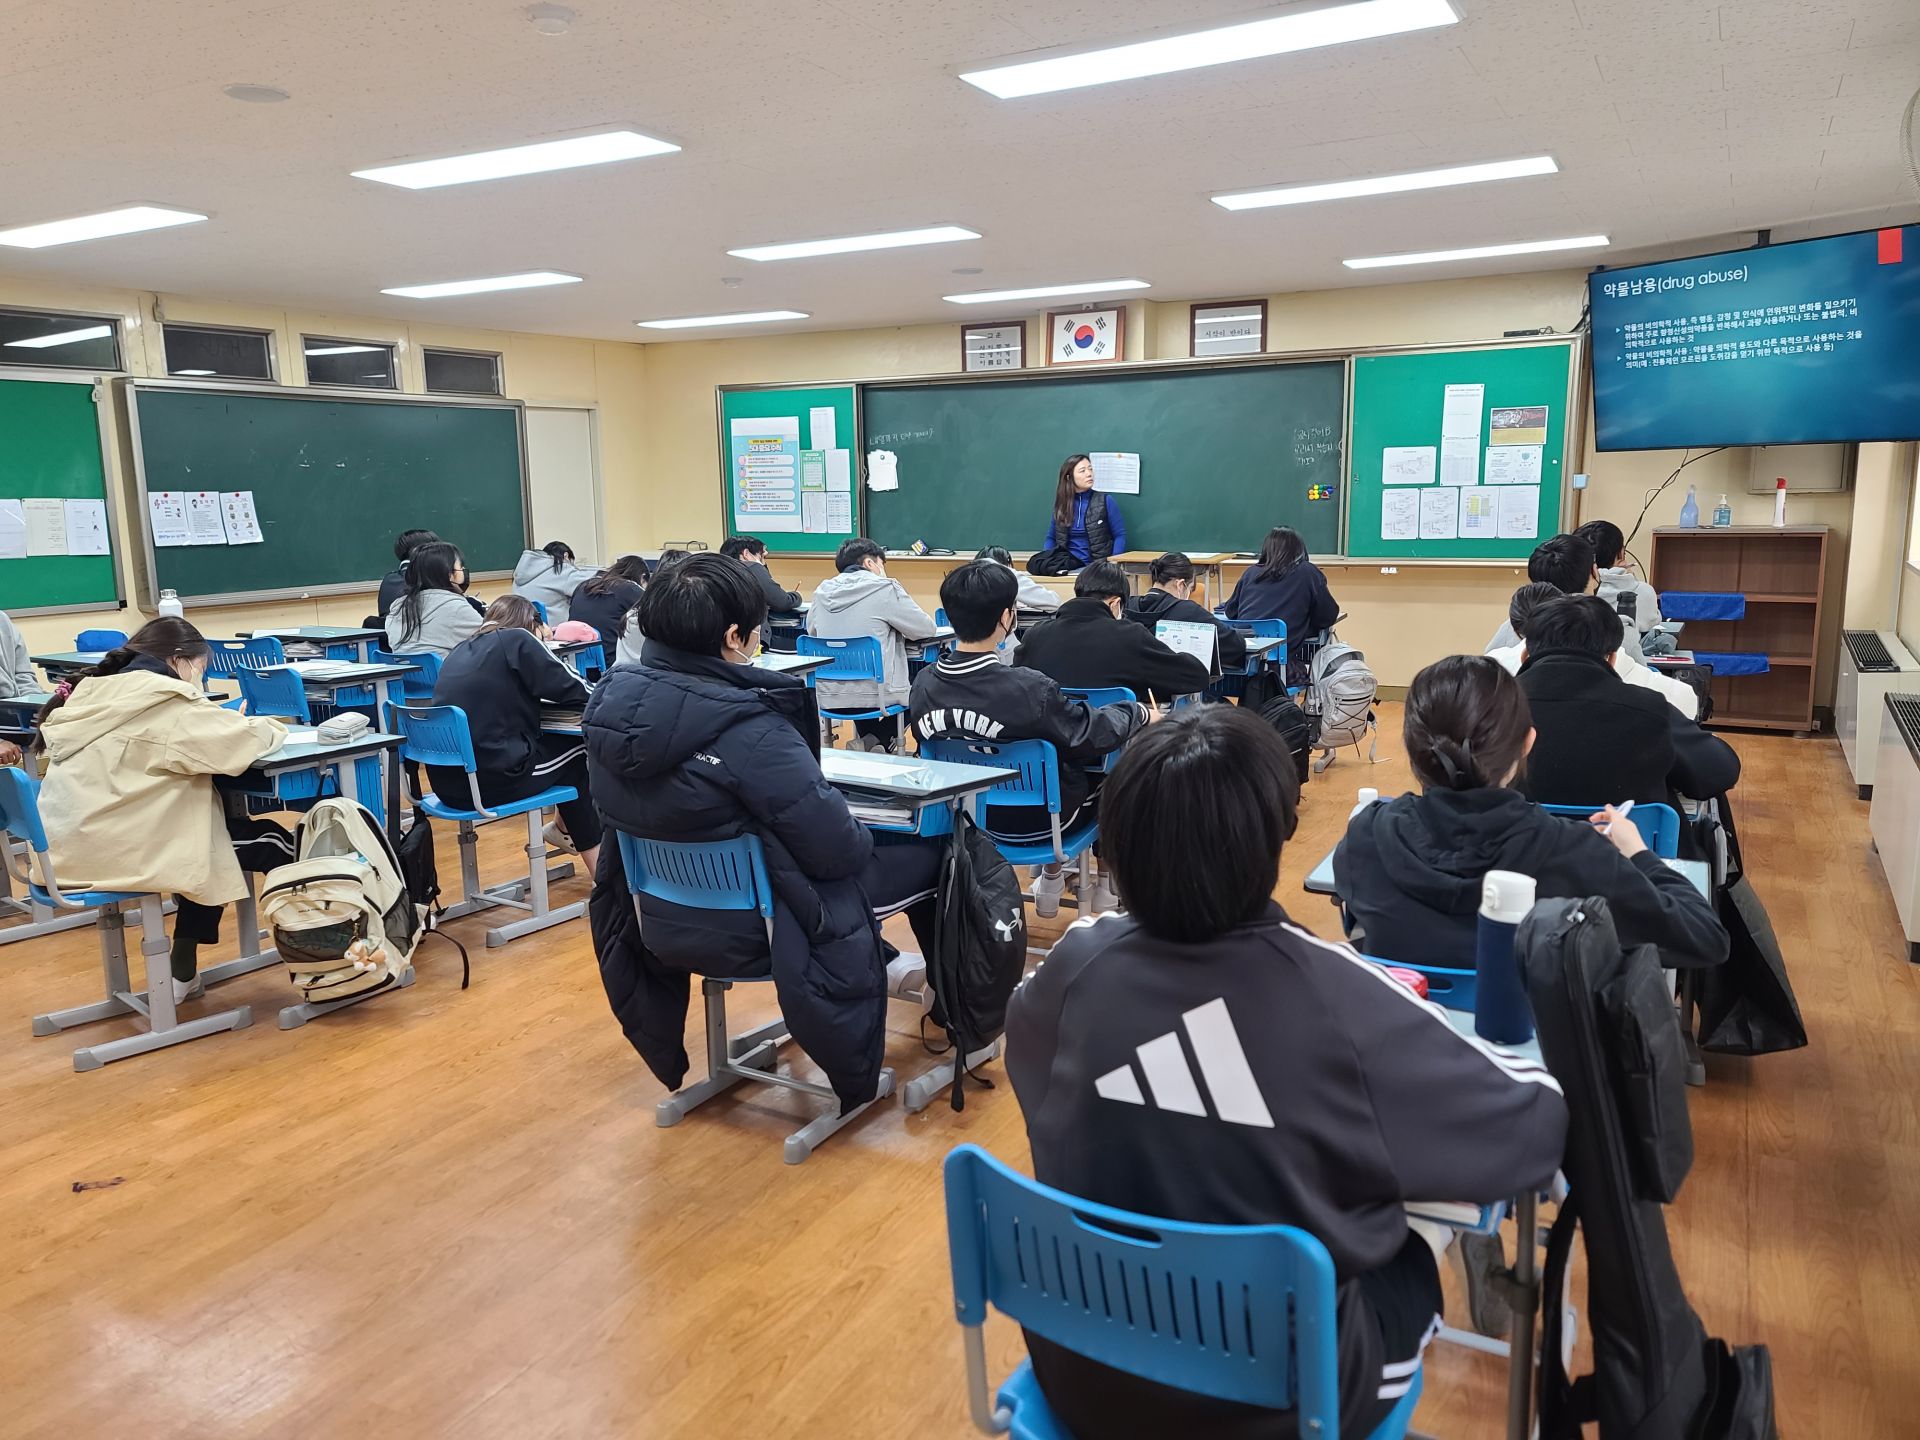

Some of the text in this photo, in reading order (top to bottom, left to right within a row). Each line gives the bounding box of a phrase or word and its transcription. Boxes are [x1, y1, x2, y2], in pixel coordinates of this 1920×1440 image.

[1604, 265, 1748, 298] 약물남용(drug abuse)
[1624, 322, 1644, 332] 약물의
[1645, 320, 1672, 330] 비의학적
[1699, 314, 1715, 323] 행동,
[1717, 312, 1731, 321] 감정
[1734, 311, 1740, 320] 및
[1742, 308, 1764, 318] 인식에
[1799, 302, 1822, 312] 변화를
[1824, 298, 1856, 310] 일으키기
[1624, 331, 1644, 340] 위하여
[1645, 330, 1658, 338] 주로
[1716, 319, 1745, 331] 반복해서
[1746, 318, 1761, 327] 과량
[1764, 313, 1801, 325] 사용하거나
[1803, 312, 1819, 321] 또는
[1822, 308, 1847, 319] 불법적,
[1850, 307, 1858, 316] 비
[1206, 328, 1251, 338] 시작이 반이다
[1625, 334, 1694, 348] 의학적으로 사용하는 것
[1625, 351, 1645, 360] 약물의
[1646, 349, 1672, 358] 비의학적
[1674, 347, 1687, 356] 사용
[1693, 344, 1714, 354] 약물을
[1716, 342, 1737, 352] 의학적
[1739, 340, 1760, 349] 용도와
[1763, 338, 1778, 346] 다른
[1780, 335, 1811, 345] 목적으로
[1812, 332, 1844, 343] 사용하는
[1846, 330, 1863, 339] 것을
[1652, 356, 1678, 366] 진통제인
[1680, 354, 1708, 363] 모르핀을
[1709, 351, 1738, 360] 도취감을
[1740, 350, 1754, 359] 얻기
[1757, 348, 1771, 357] 위한
[1774, 346, 1803, 355] 목적으로
[1805, 344, 1821, 353] 사용
[1823, 342, 1834, 352] 등)
[952, 708, 1005, 739] YORK
